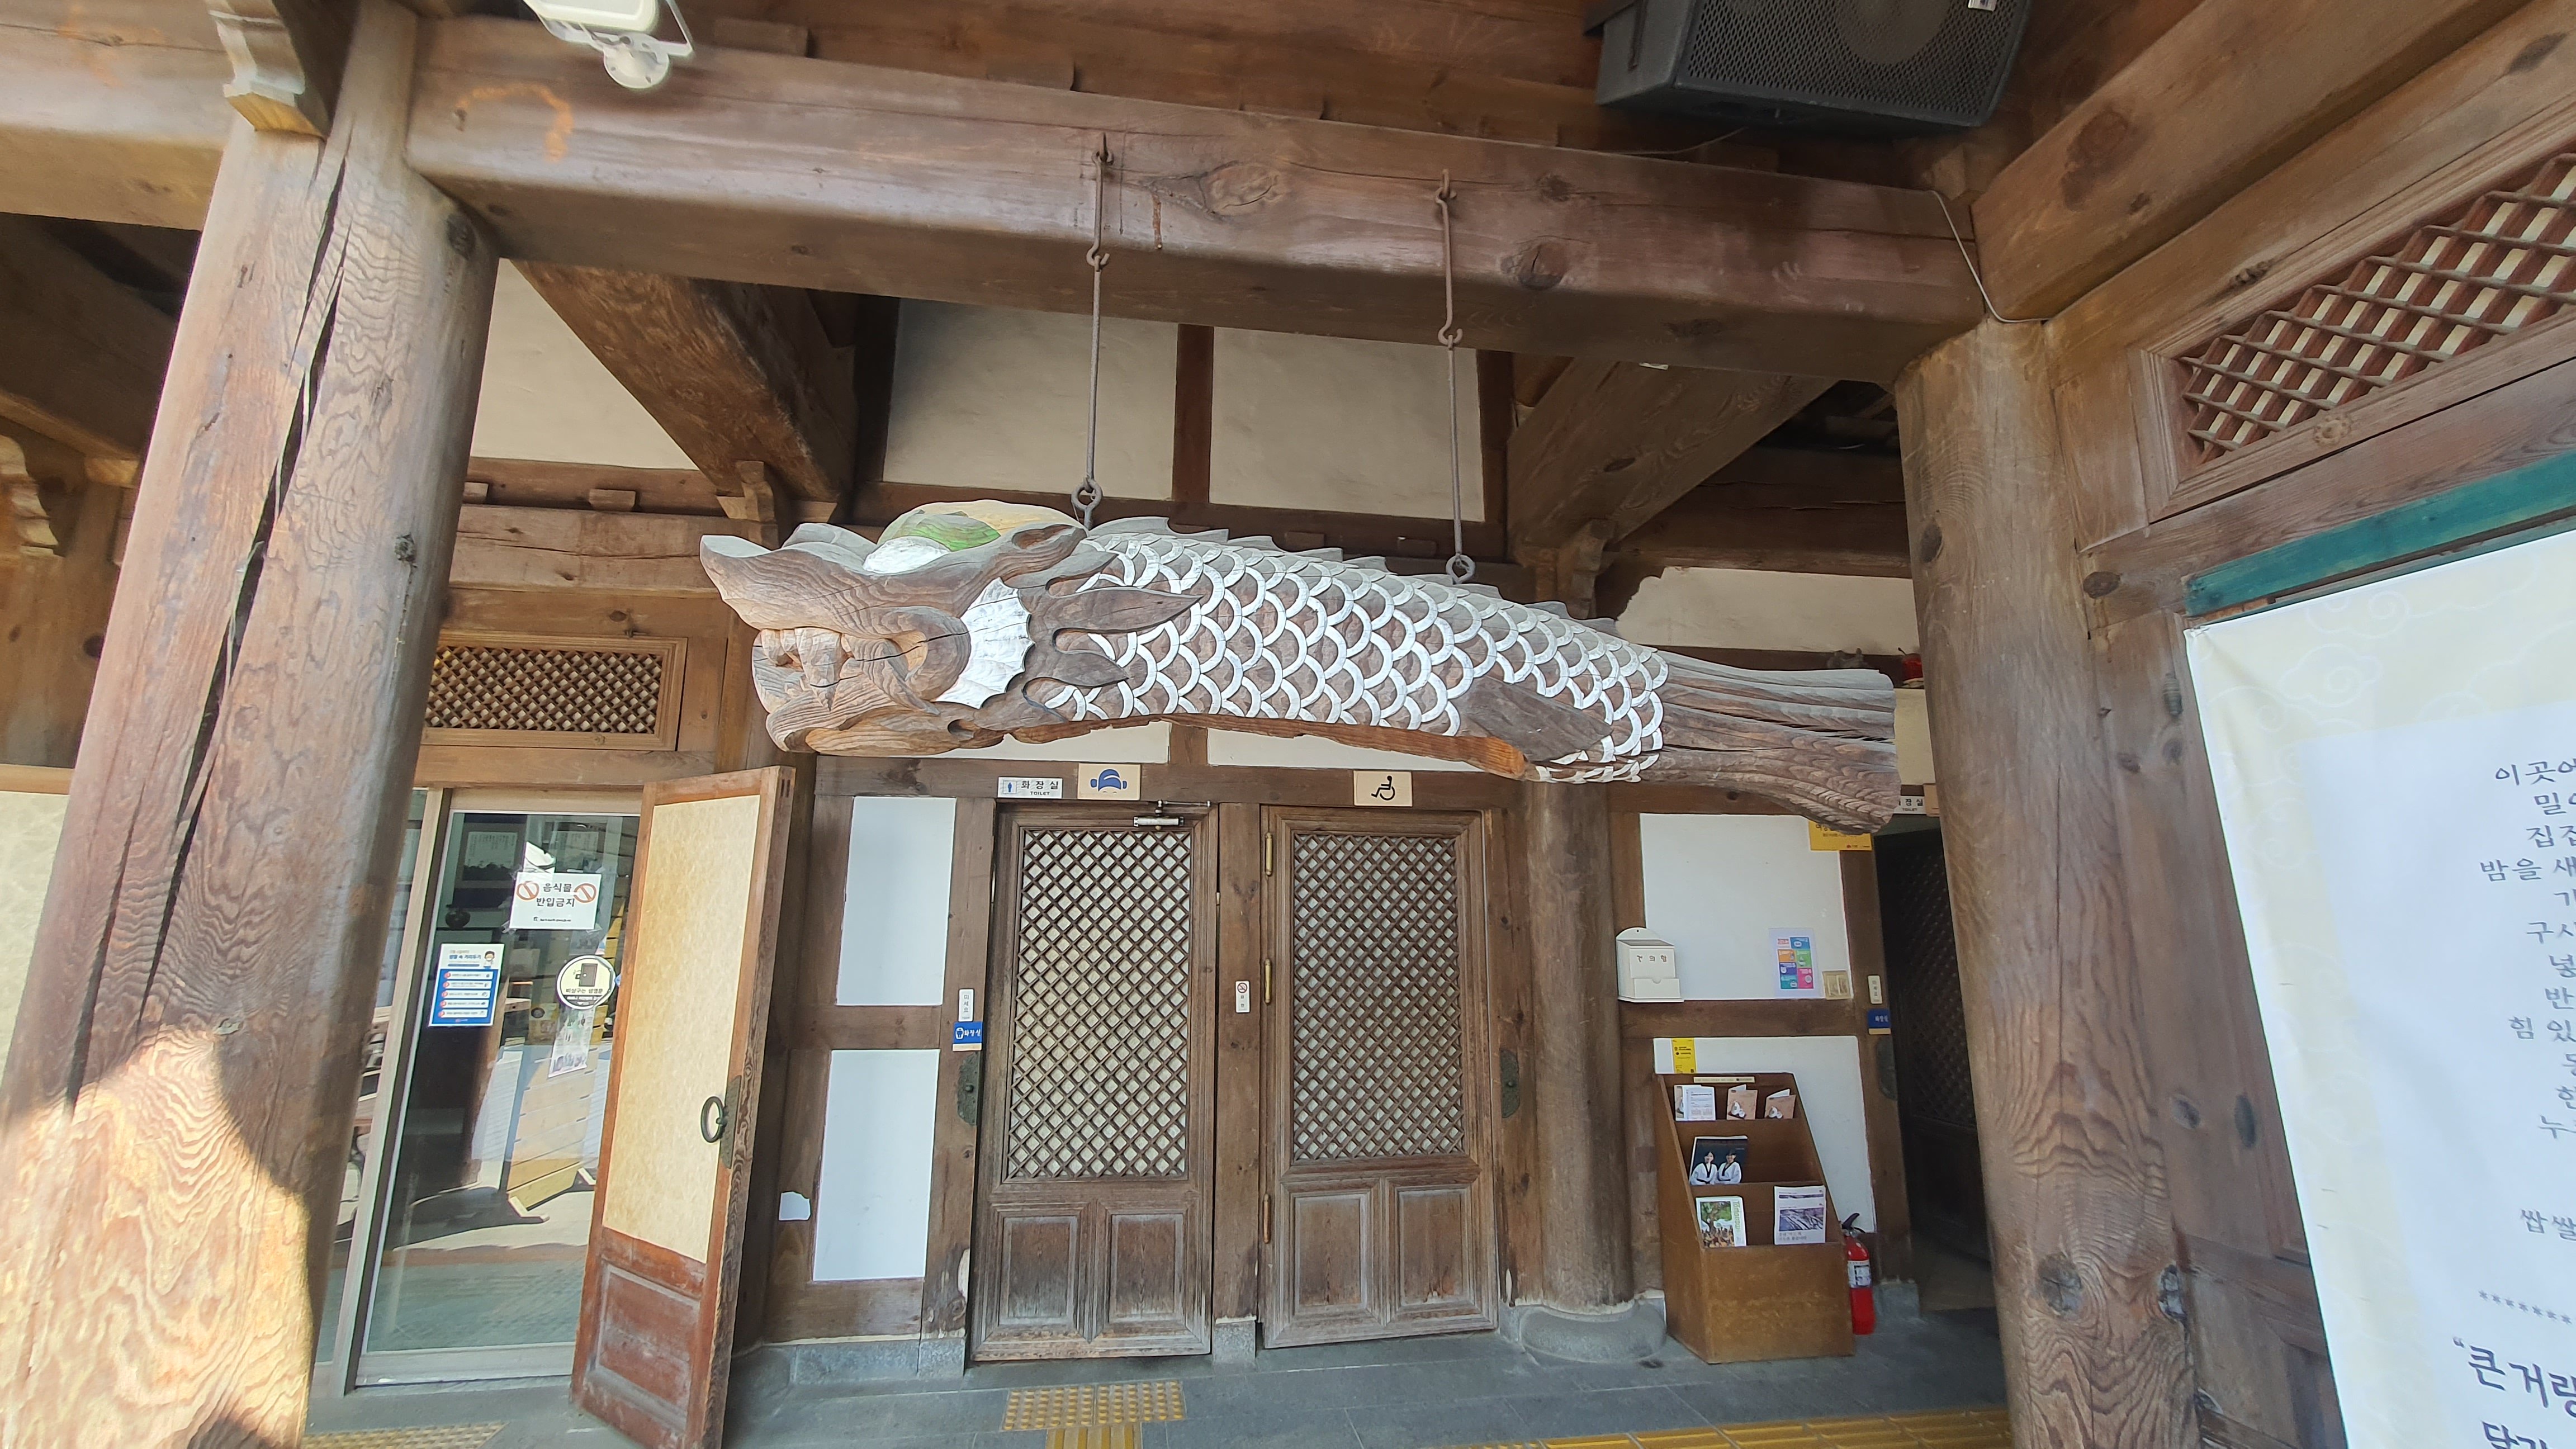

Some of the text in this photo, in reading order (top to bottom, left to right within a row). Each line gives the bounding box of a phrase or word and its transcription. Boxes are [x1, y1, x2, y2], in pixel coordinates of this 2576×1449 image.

[1021, 780, 1059, 790] 화장실
[2480, 858, 2542, 882] 밤을
[542, 883, 572, 893] 음식물
[536, 897, 575, 907] 반입금지
[2508, 1016, 2534, 1040] 힘
[2538, 1115, 2576, 1139] 누
